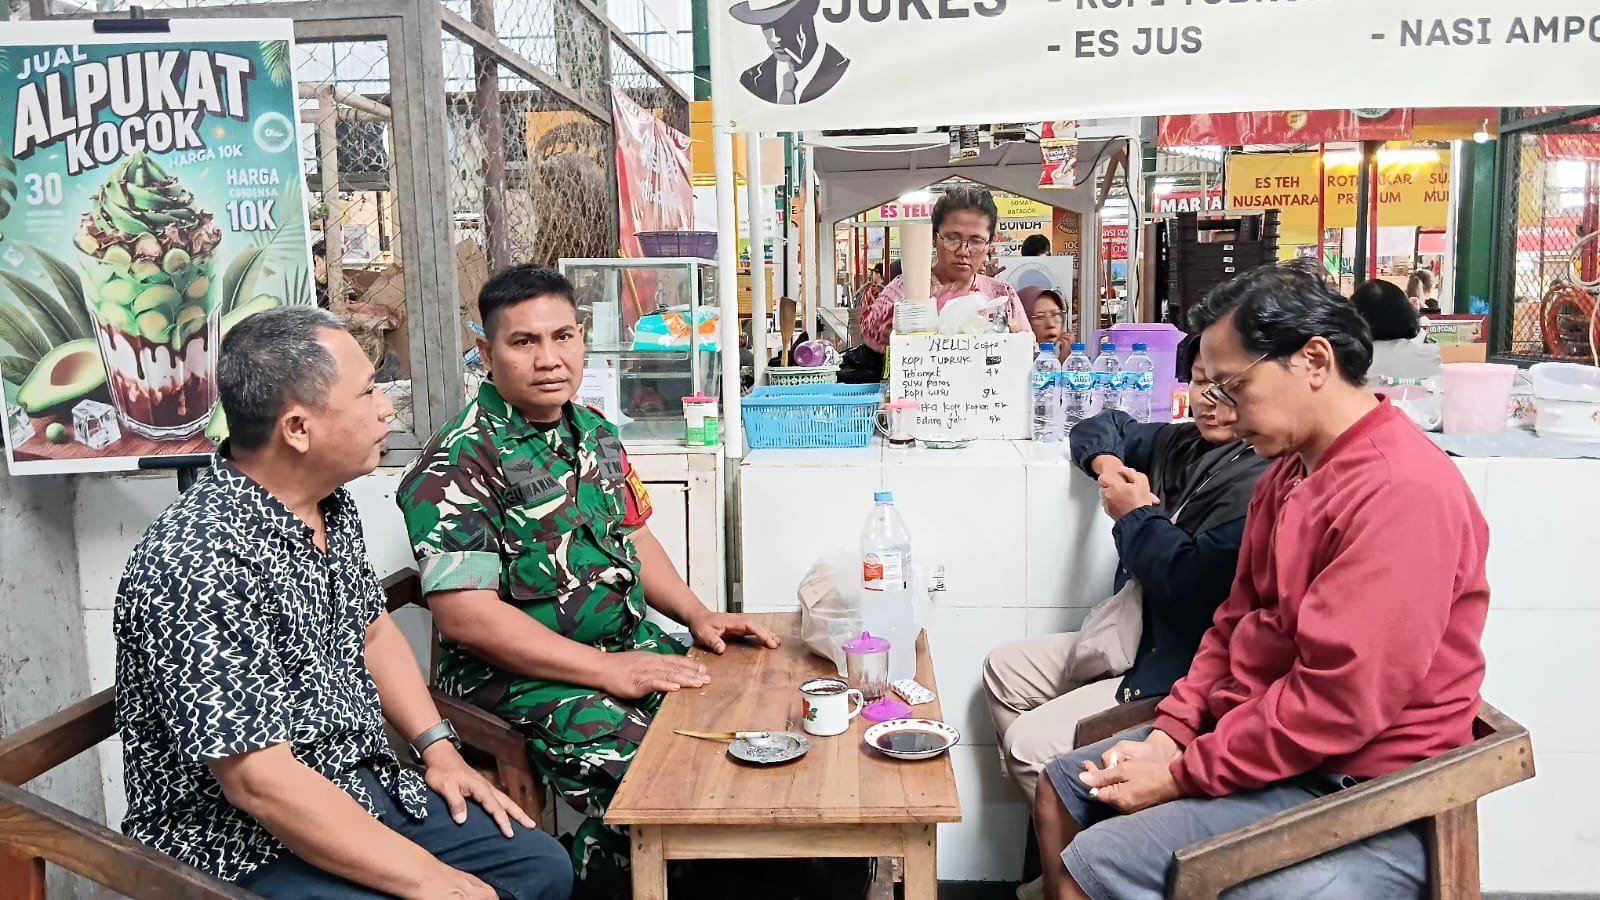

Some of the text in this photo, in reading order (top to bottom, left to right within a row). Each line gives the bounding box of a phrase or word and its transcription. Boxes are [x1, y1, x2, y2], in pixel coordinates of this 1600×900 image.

[1075, 29, 1119, 58] ES
[1132, 26, 1202, 56] JUS
[1400, 18, 1491, 46] NASI
[17, 44, 88, 80] JUAL
[13, 50, 251, 158] ALPUKAT
[66, 110, 203, 175] KOCOK
[169, 144, 243, 167] HARGA 10K
[24, 172, 63, 206] 30
[226, 168, 280, 186] HARGA
[1255, 176, 1300, 188] ES TEH
[226, 199, 277, 232] 10K
[880, 205, 898, 219] ES
[1233, 194, 1319, 207] NUSANTARA
